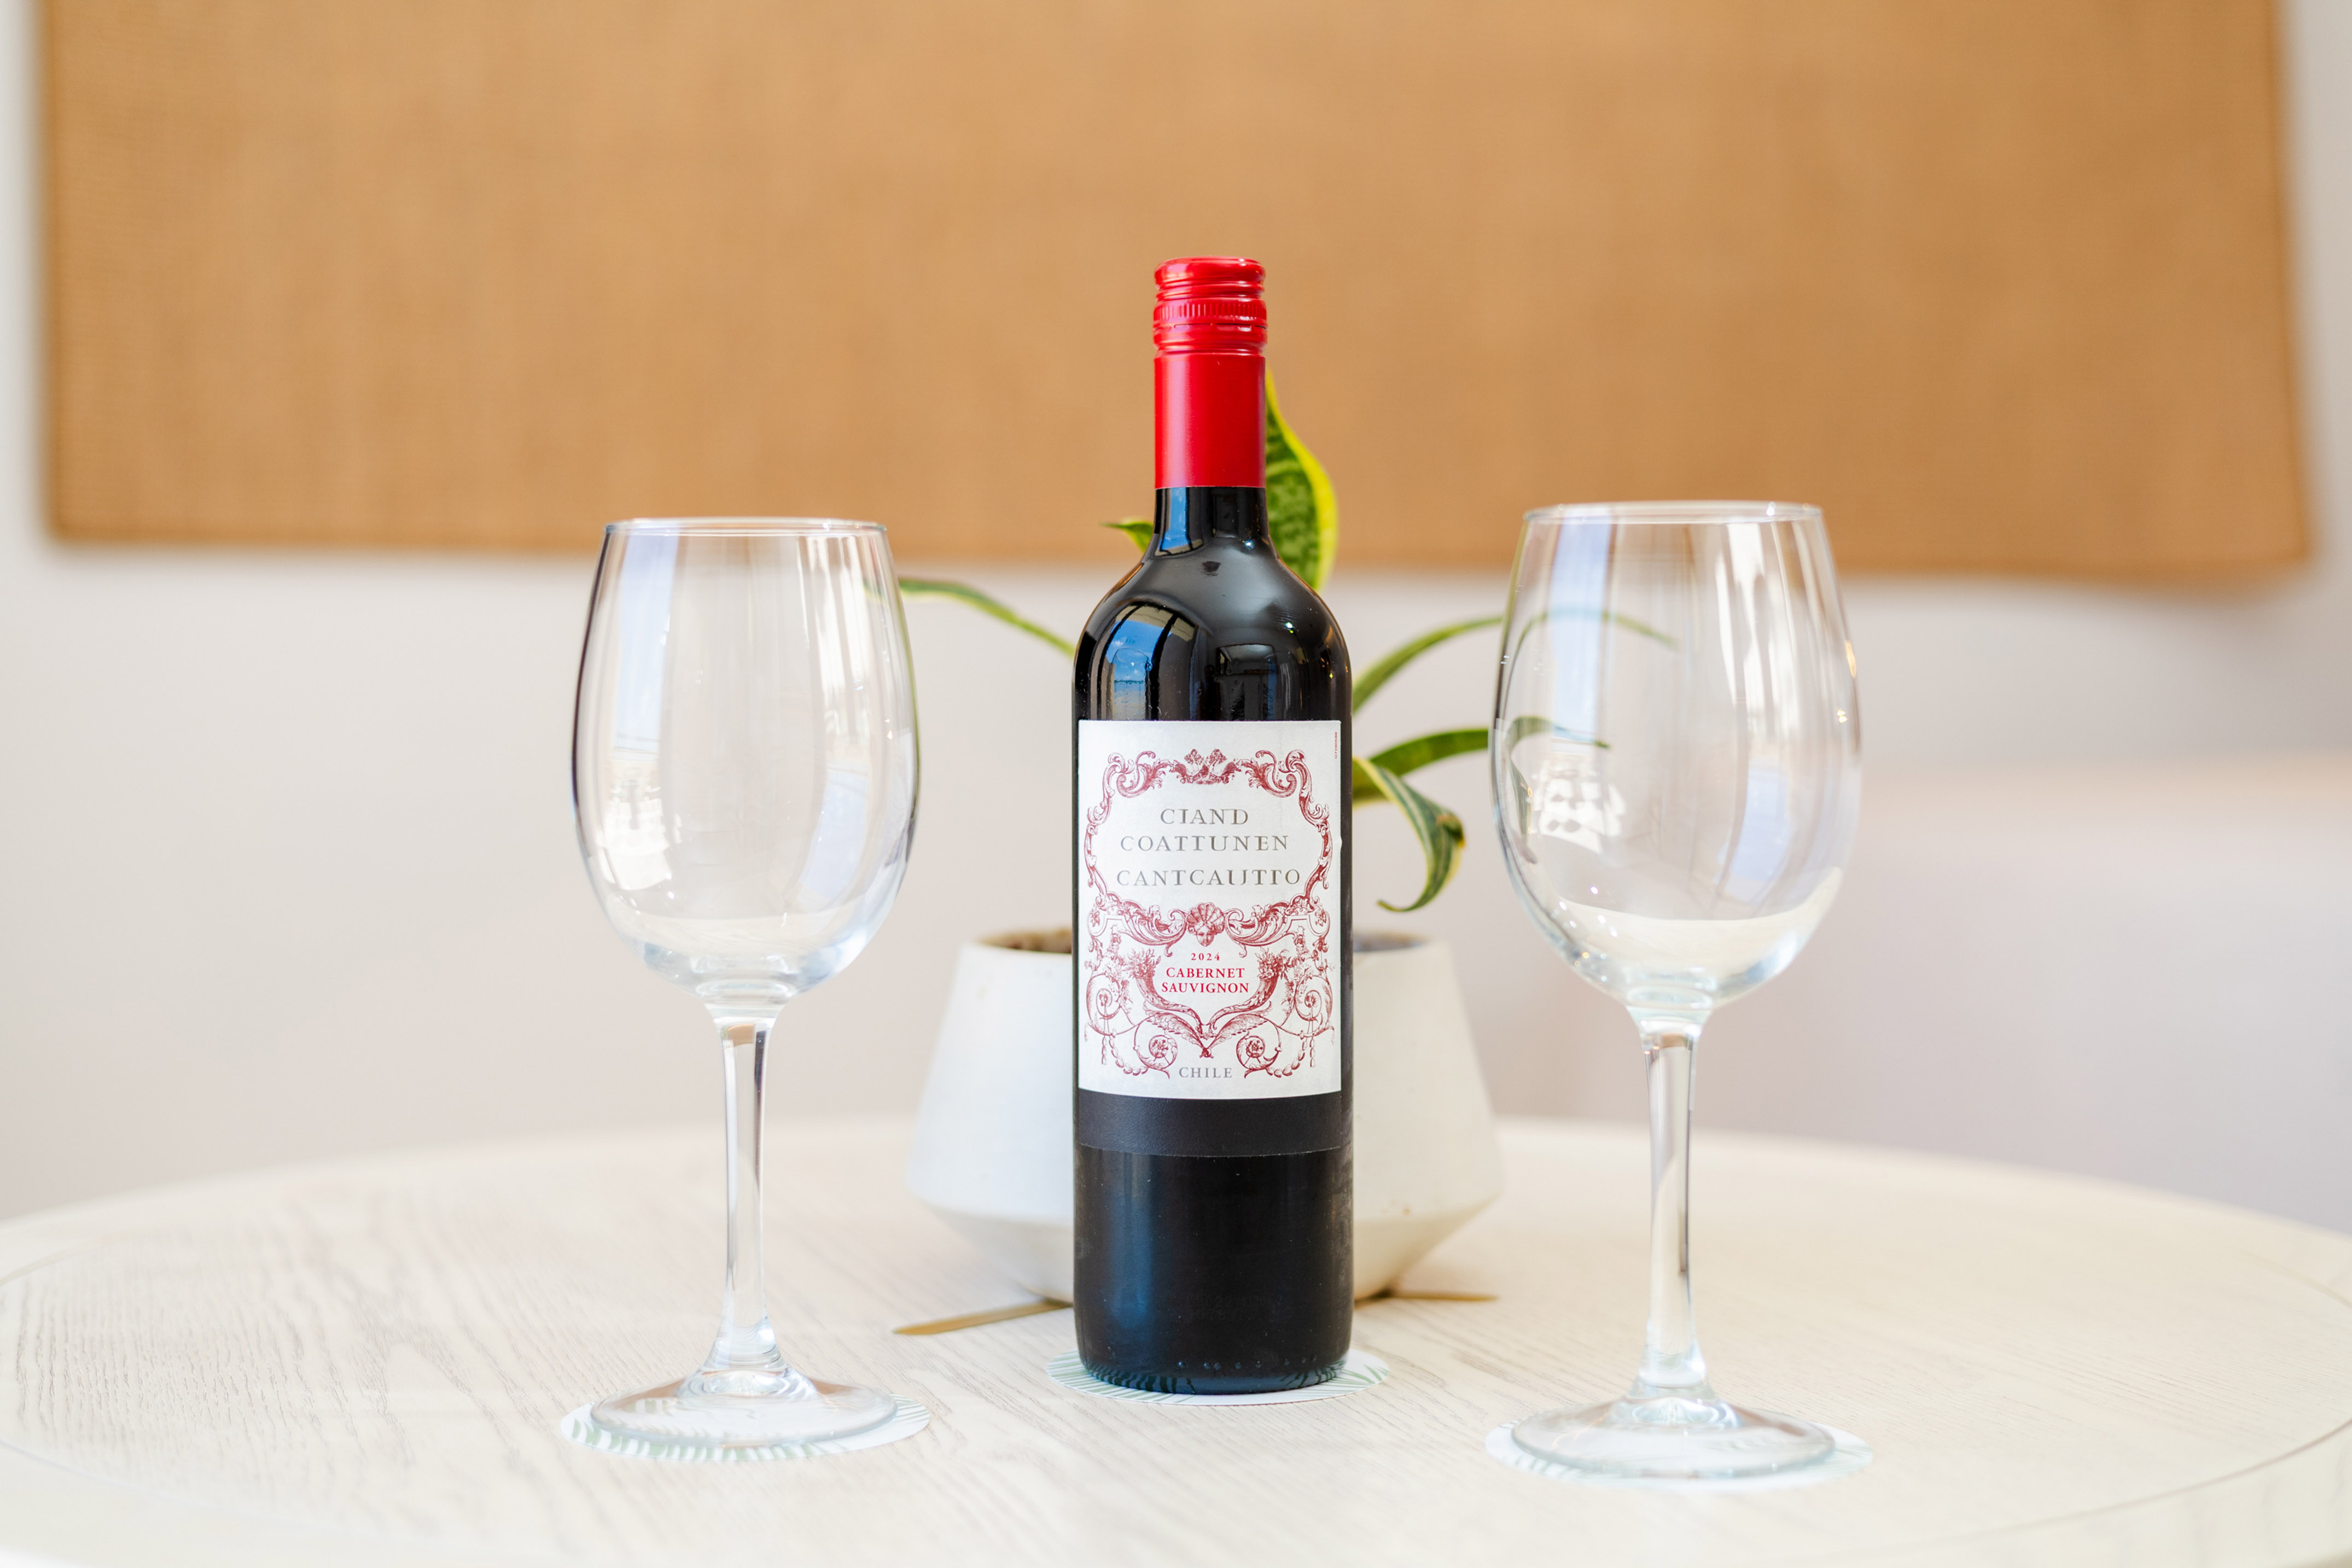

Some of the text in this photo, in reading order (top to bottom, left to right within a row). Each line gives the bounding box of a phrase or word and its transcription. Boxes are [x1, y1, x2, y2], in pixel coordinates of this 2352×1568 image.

[1120, 835, 1289, 852] COATTUNEN
[1191, 952, 1220, 961] 2024
[1166, 967, 1245, 978] CABERNET
[1161, 982, 1250, 994] SAUVIGNON
[1178, 1067, 1232, 1079] CHILE
